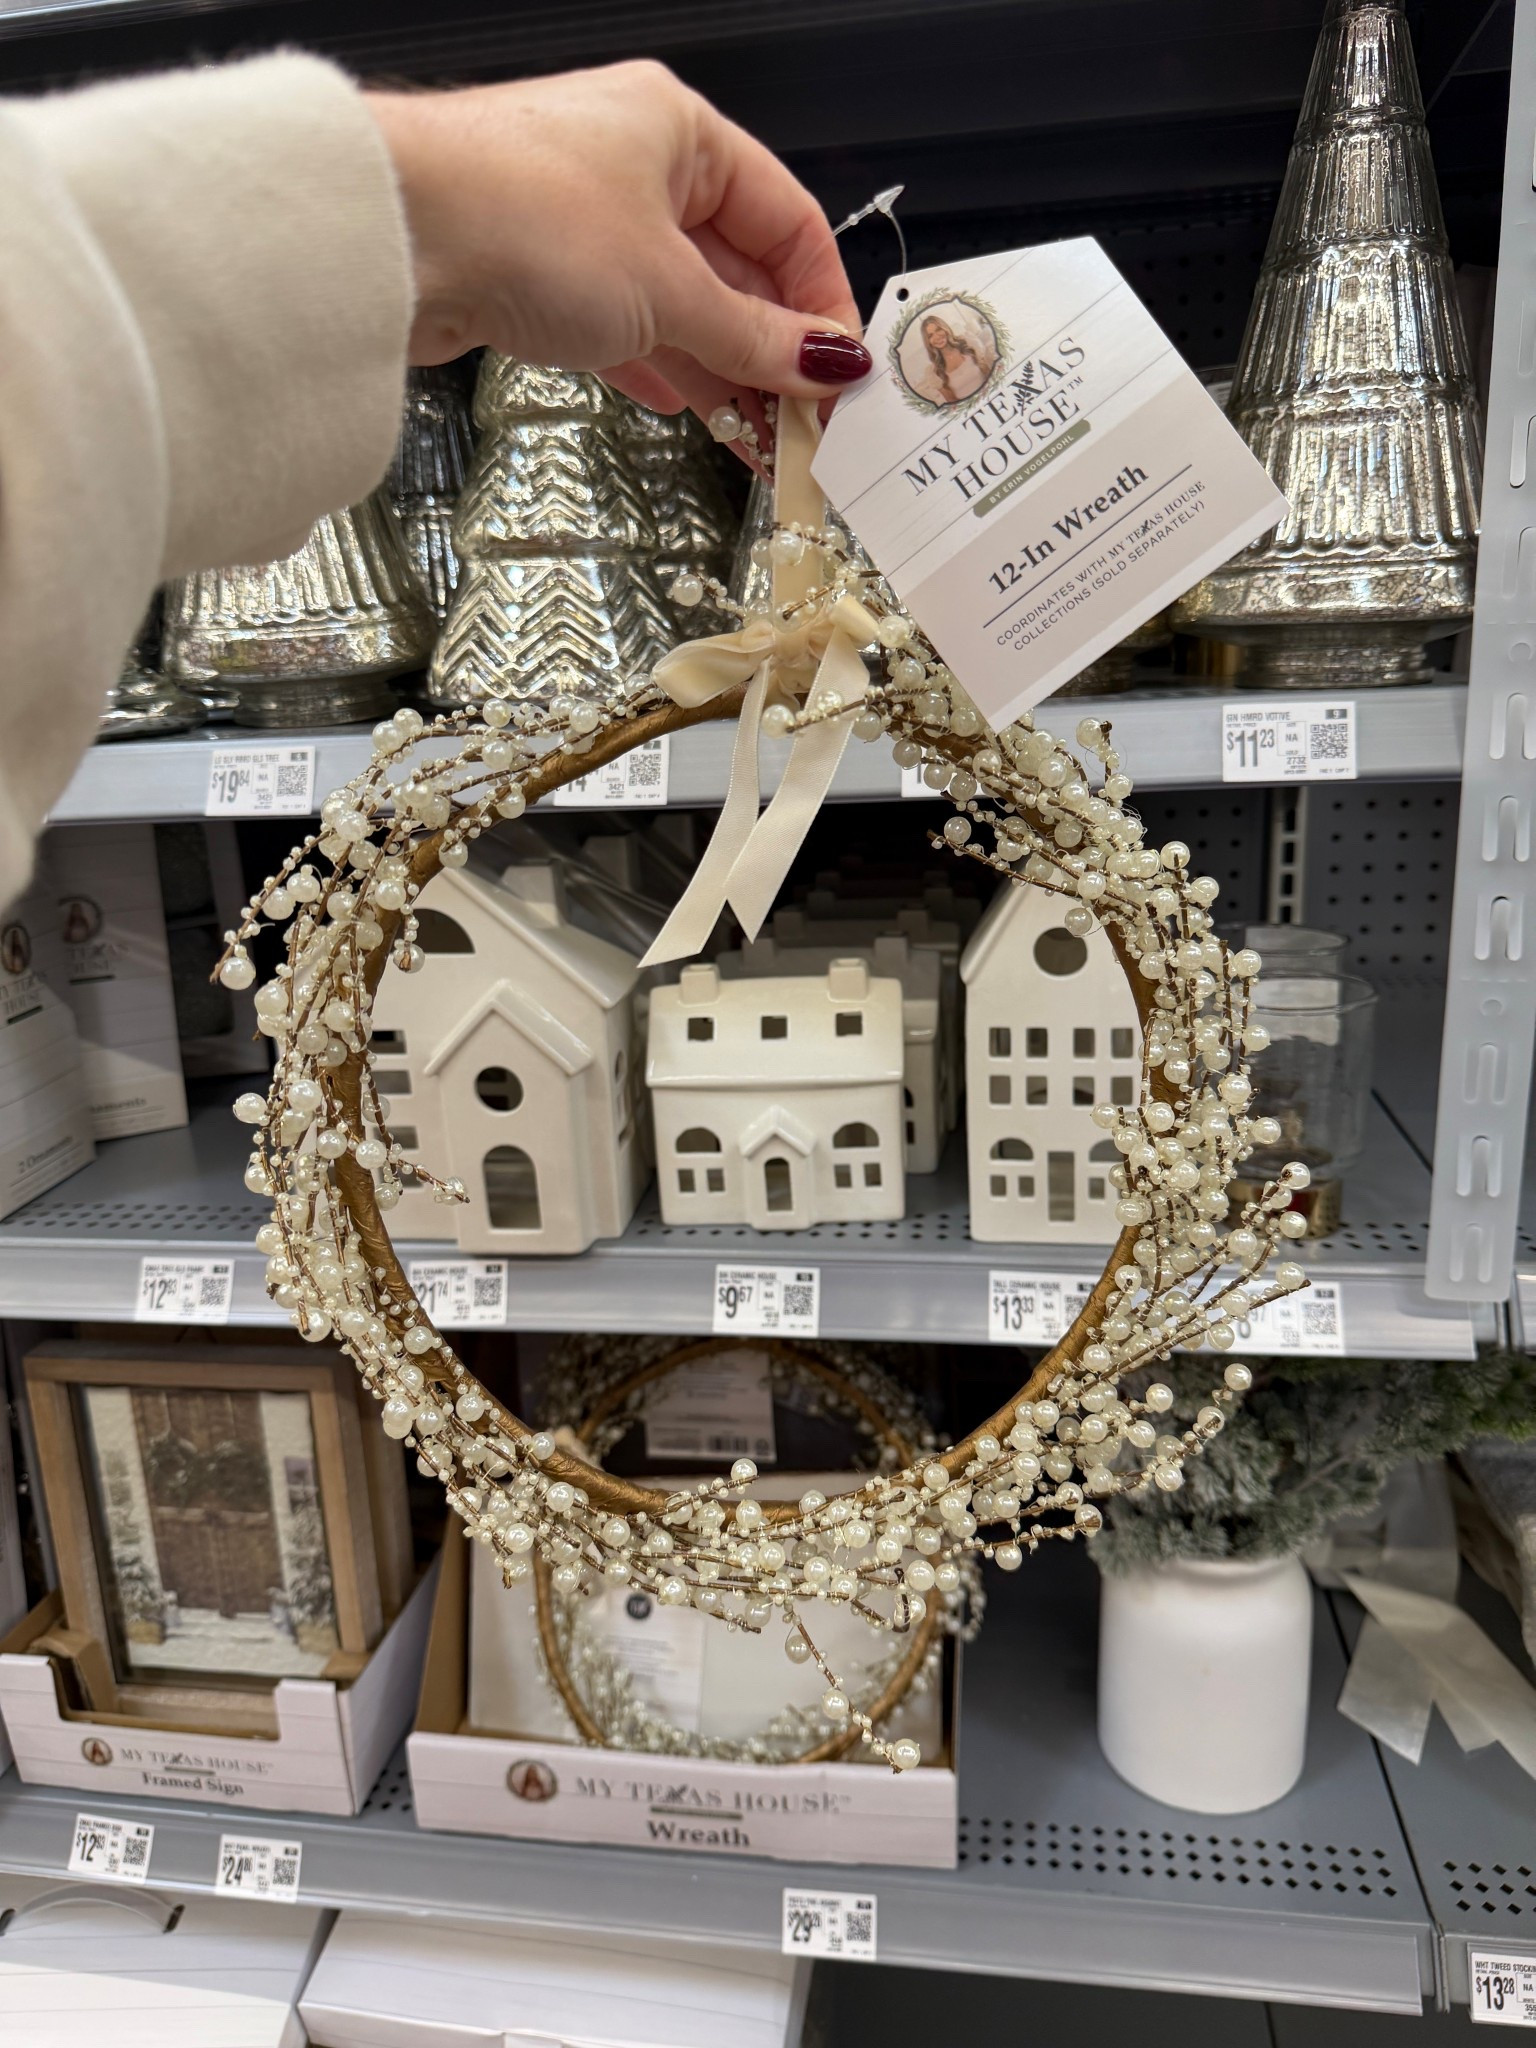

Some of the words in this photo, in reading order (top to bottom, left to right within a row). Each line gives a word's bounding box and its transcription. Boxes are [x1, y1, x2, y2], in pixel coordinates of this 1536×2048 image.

[901, 434, 960, 496] MY
[962, 337, 1085, 442] TEXAS
[988, 493, 1003, 505] BY
[1002, 474, 1024, 494] ERIN
[1023, 434, 1075, 476] VOGELPOHL
[988, 537, 1057, 595] 12-In
[1052, 464, 1150, 540] Wreath
[996, 581, 1076, 647] COORDINATES
[1075, 556, 1108, 583] WITH
[1107, 541, 1126, 560] MY
[1125, 512, 1163, 545] TEXAS
[1164, 480, 1206, 515] HOUSE
[1014, 589, 1092, 651] COLLECTIONS
[1091, 559, 1127, 592] (SOLD
[1129, 500, 1206, 563] SEPARATELY)
[1265, 711, 1291, 721] VOTIVE
[1285, 733, 1298, 742] NA
[142, 1771, 203, 1790] Framed
[207, 1777, 245, 1797] Sign
[576, 1776, 613, 1799] MY
[626, 1781, 723, 1808] TEXAS
[647, 1820, 751, 1848] Wreath
[1475, 1961, 1488, 1969] WHT
[1491, 1962, 1512, 1971] TWEED
[1523, 1983, 1534, 1992] NA
